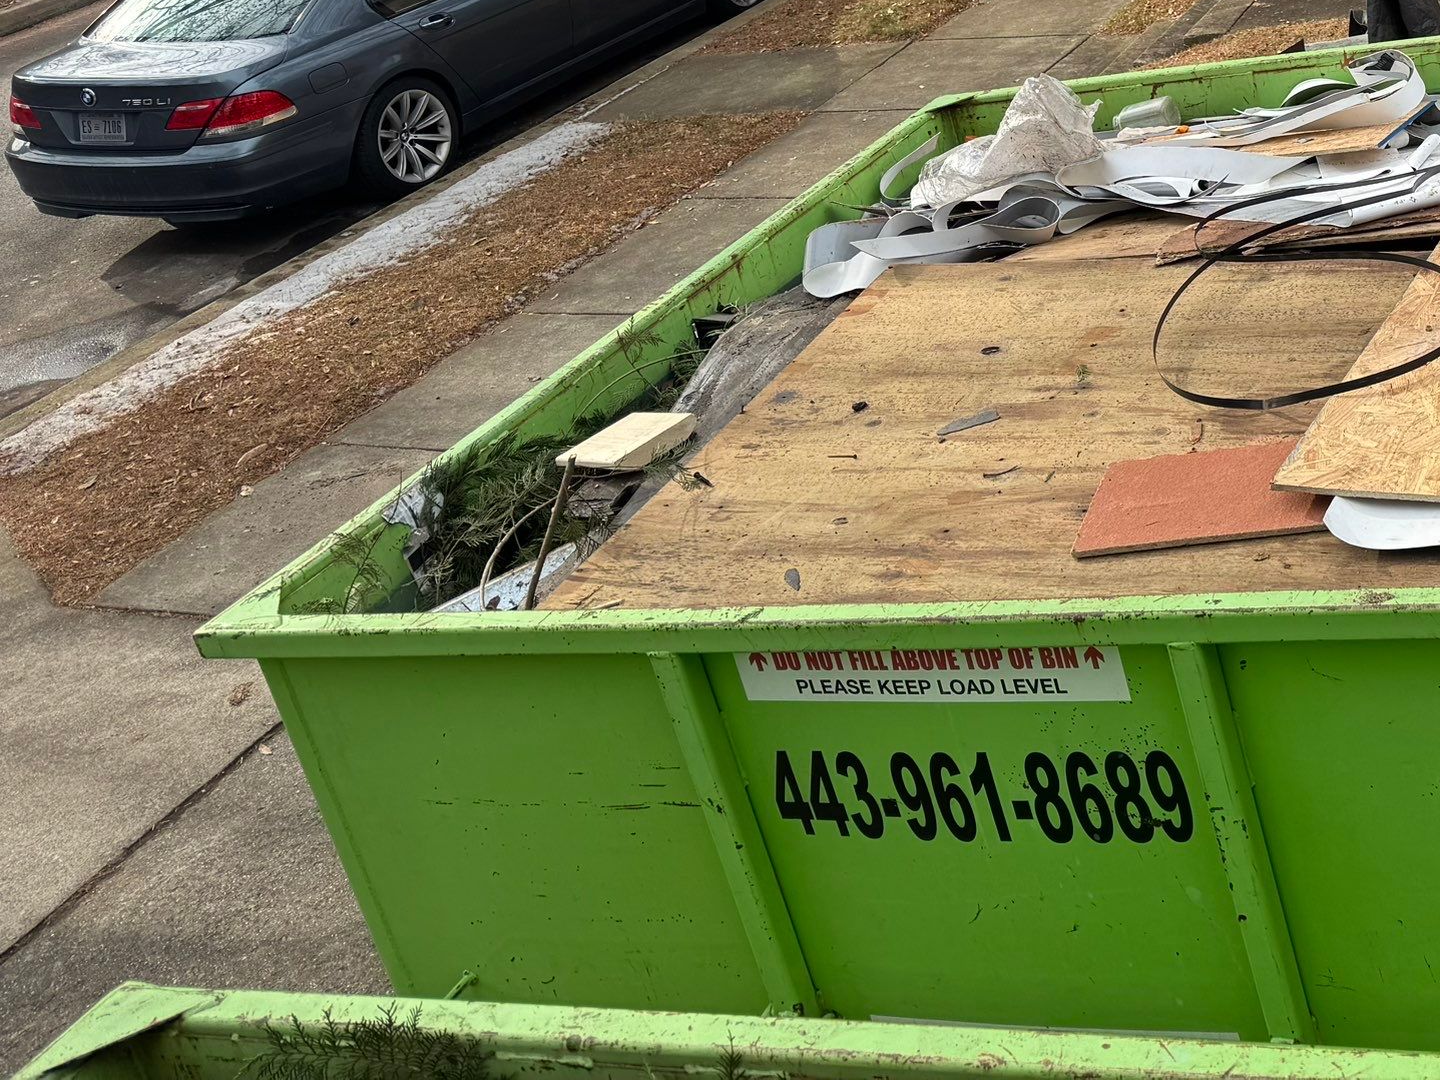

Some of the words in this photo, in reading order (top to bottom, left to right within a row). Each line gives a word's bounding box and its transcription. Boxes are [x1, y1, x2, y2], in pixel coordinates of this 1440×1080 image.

[771, 652, 801, 671] DO
[803, 651, 844, 671] NOT
[847, 650, 888, 671] FILL
[890, 649, 961, 671] ABOVE
[961, 648, 1003, 670] TOP
[1007, 647, 1035, 670] OF
[1038, 646, 1079, 670] BIN
[795, 679, 874, 695] PLEASE
[877, 679, 931, 695] KEEP
[937, 678, 995, 695] LOAD
[1000, 678, 1068, 695] LEVEL
[775, 750, 1194, 844] 443-961-8689
